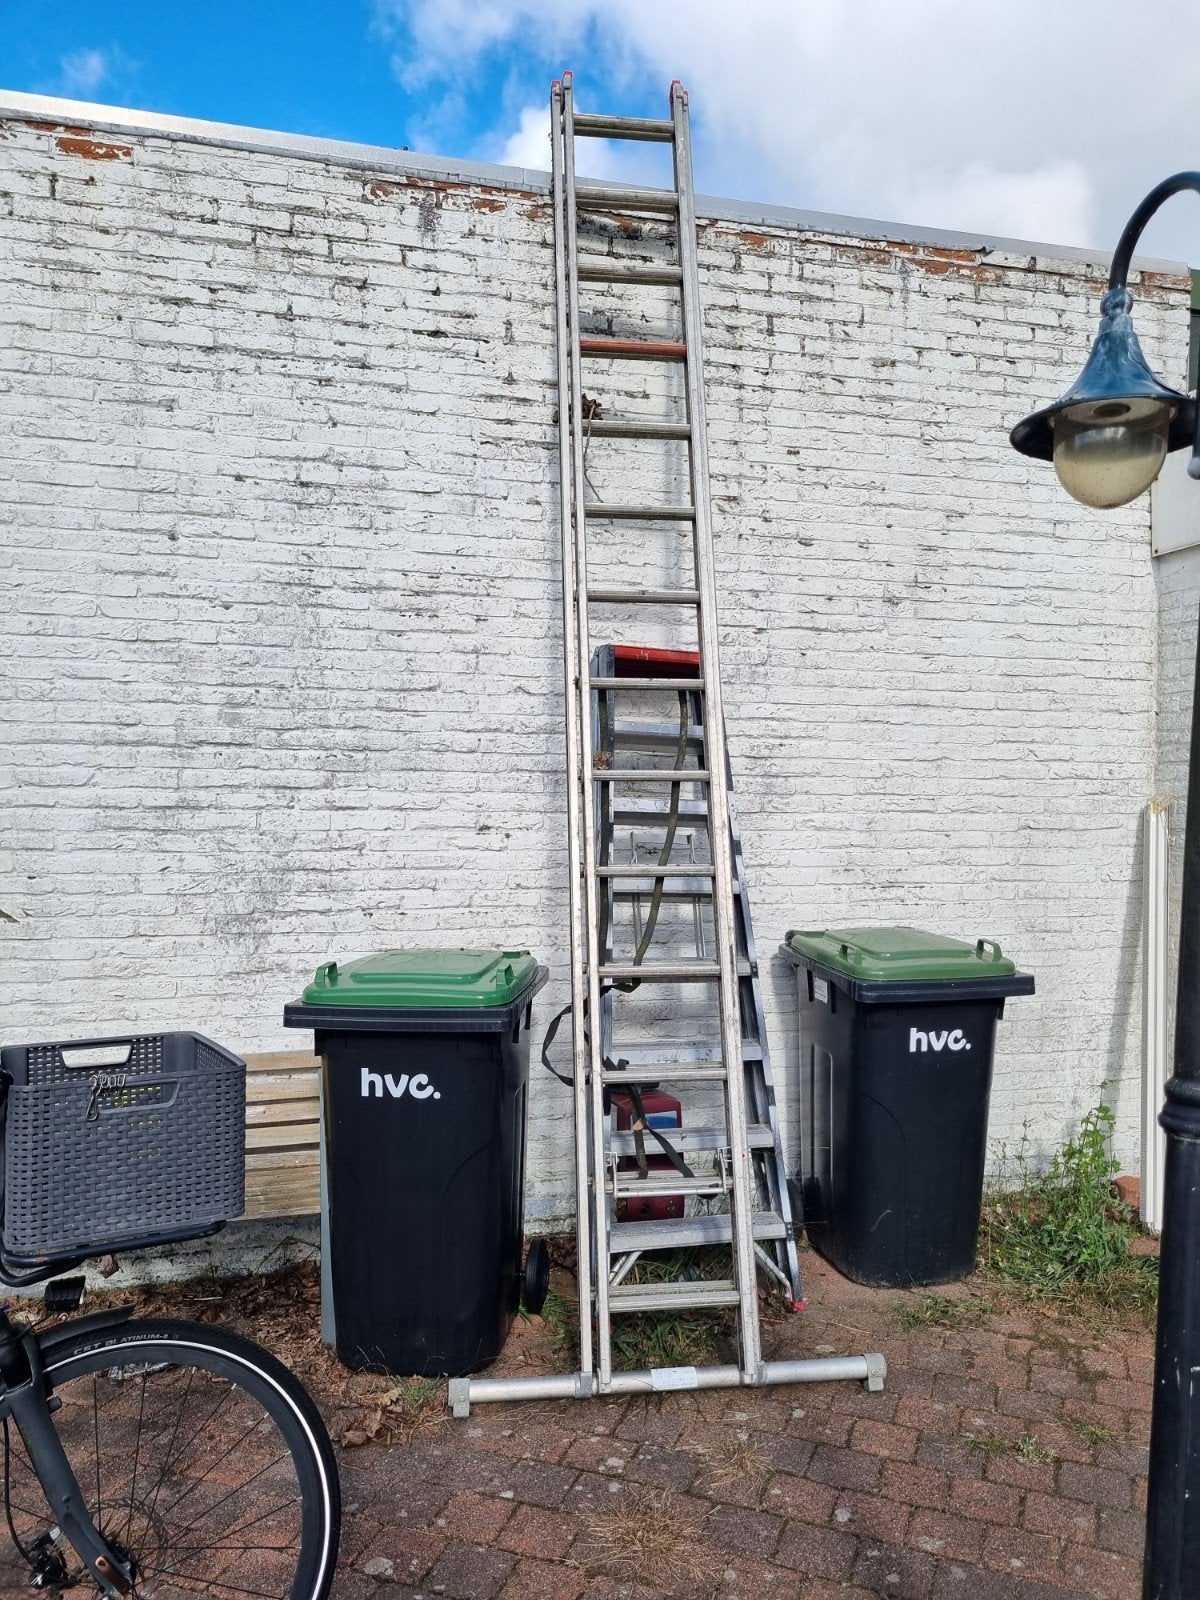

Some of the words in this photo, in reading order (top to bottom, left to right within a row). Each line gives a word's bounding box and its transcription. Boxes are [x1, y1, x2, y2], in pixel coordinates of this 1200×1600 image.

[909, 1027, 972, 1053] hvc.
[361, 1067, 441, 1100] hvc.
[73, 1342, 102, 1356] CST
